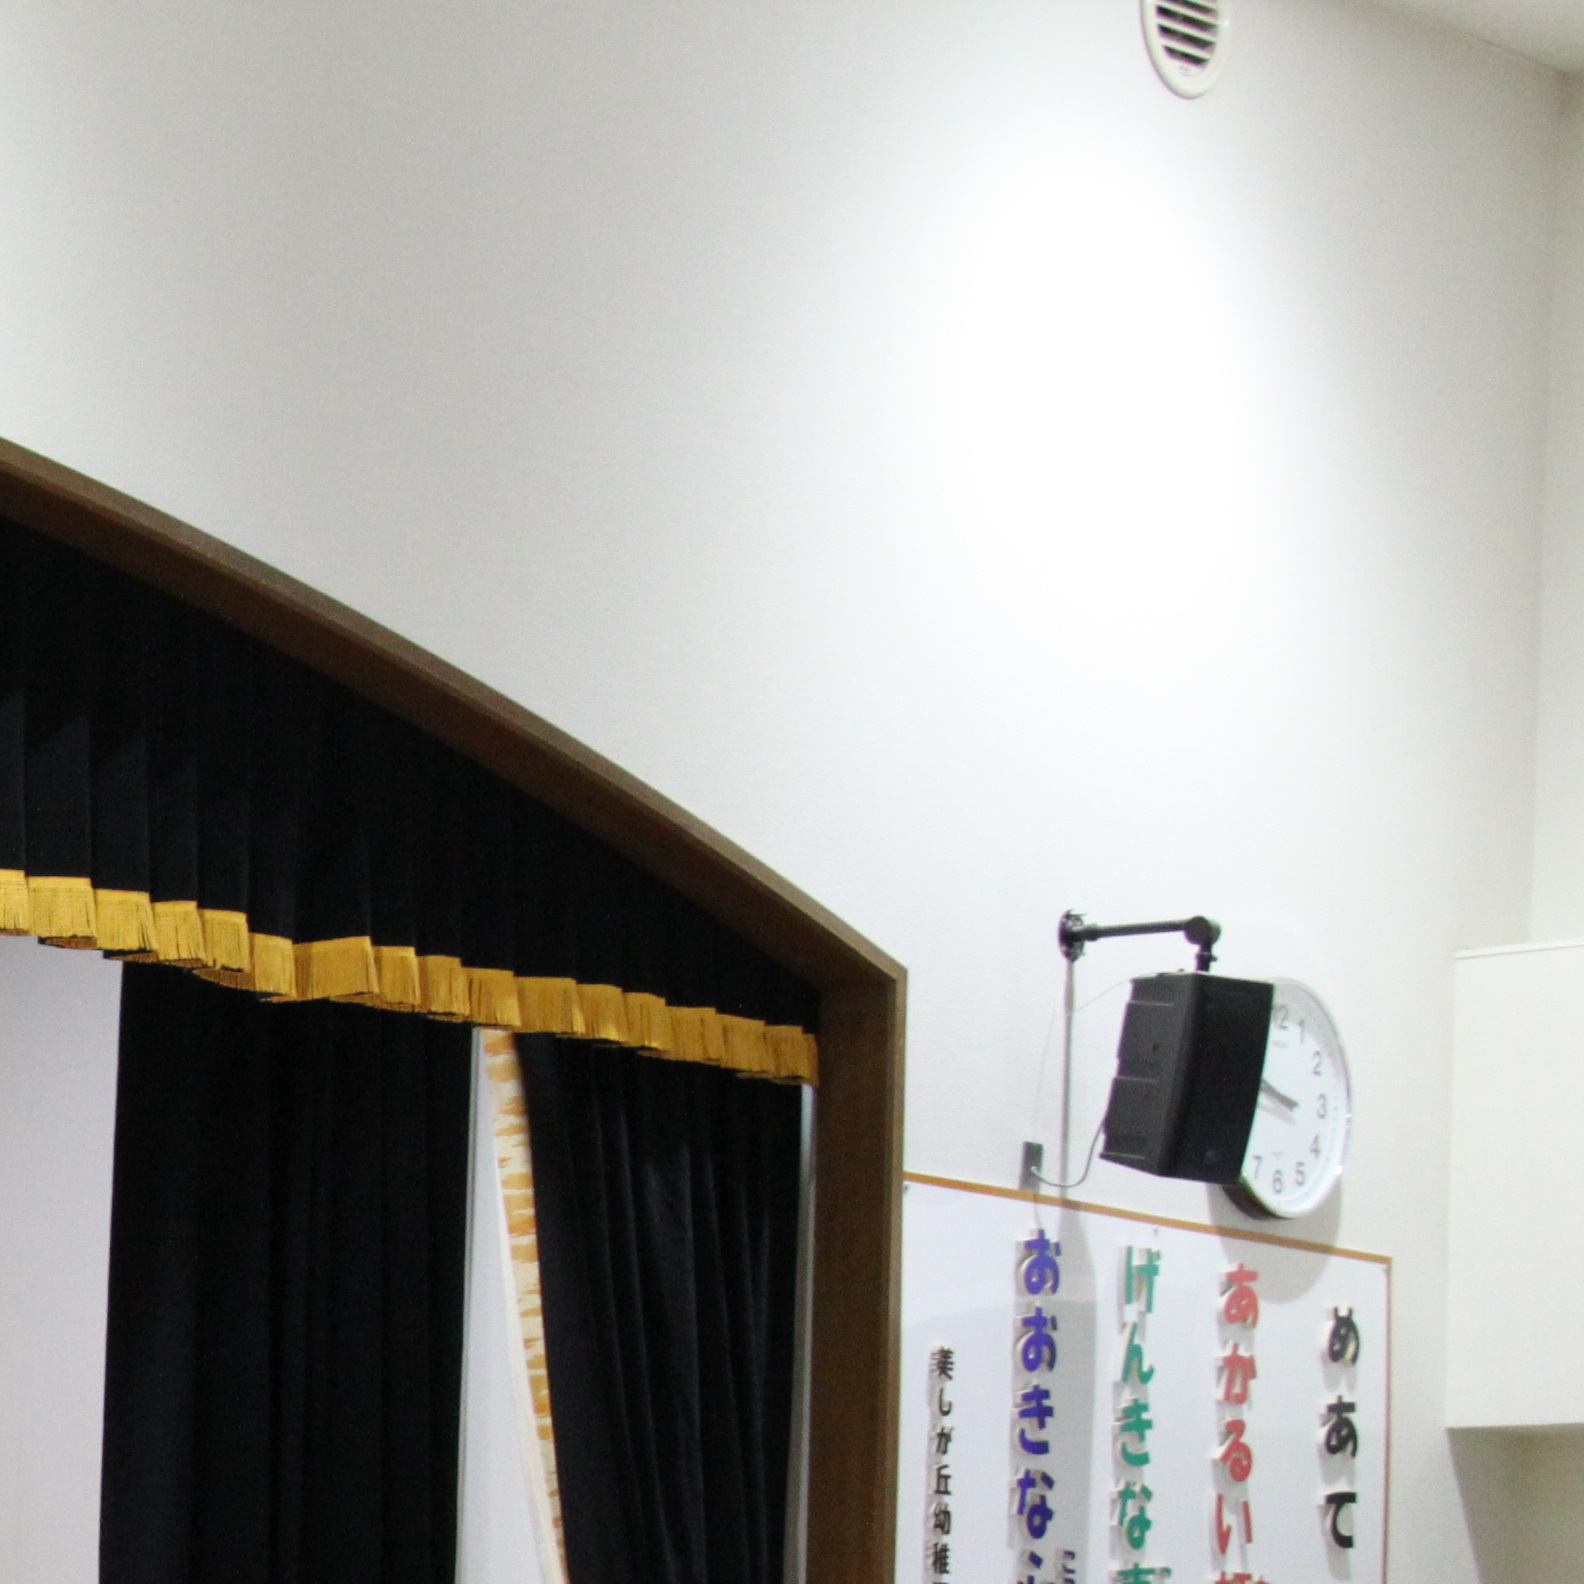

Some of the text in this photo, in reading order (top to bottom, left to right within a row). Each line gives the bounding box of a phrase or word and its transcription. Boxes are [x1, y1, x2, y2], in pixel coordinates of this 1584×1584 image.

[1313, 1051, 1322, 1076] 2
[1317, 1094, 1327, 1118] 3
[1310, 1135, 1320, 1158] 4
[1253, 1156, 1263, 1180] 7
[1295, 1162, 1305, 1186] 5
[1272, 1170, 1282, 1193] 6
[1325, 1306, 1359, 1549] めあて
